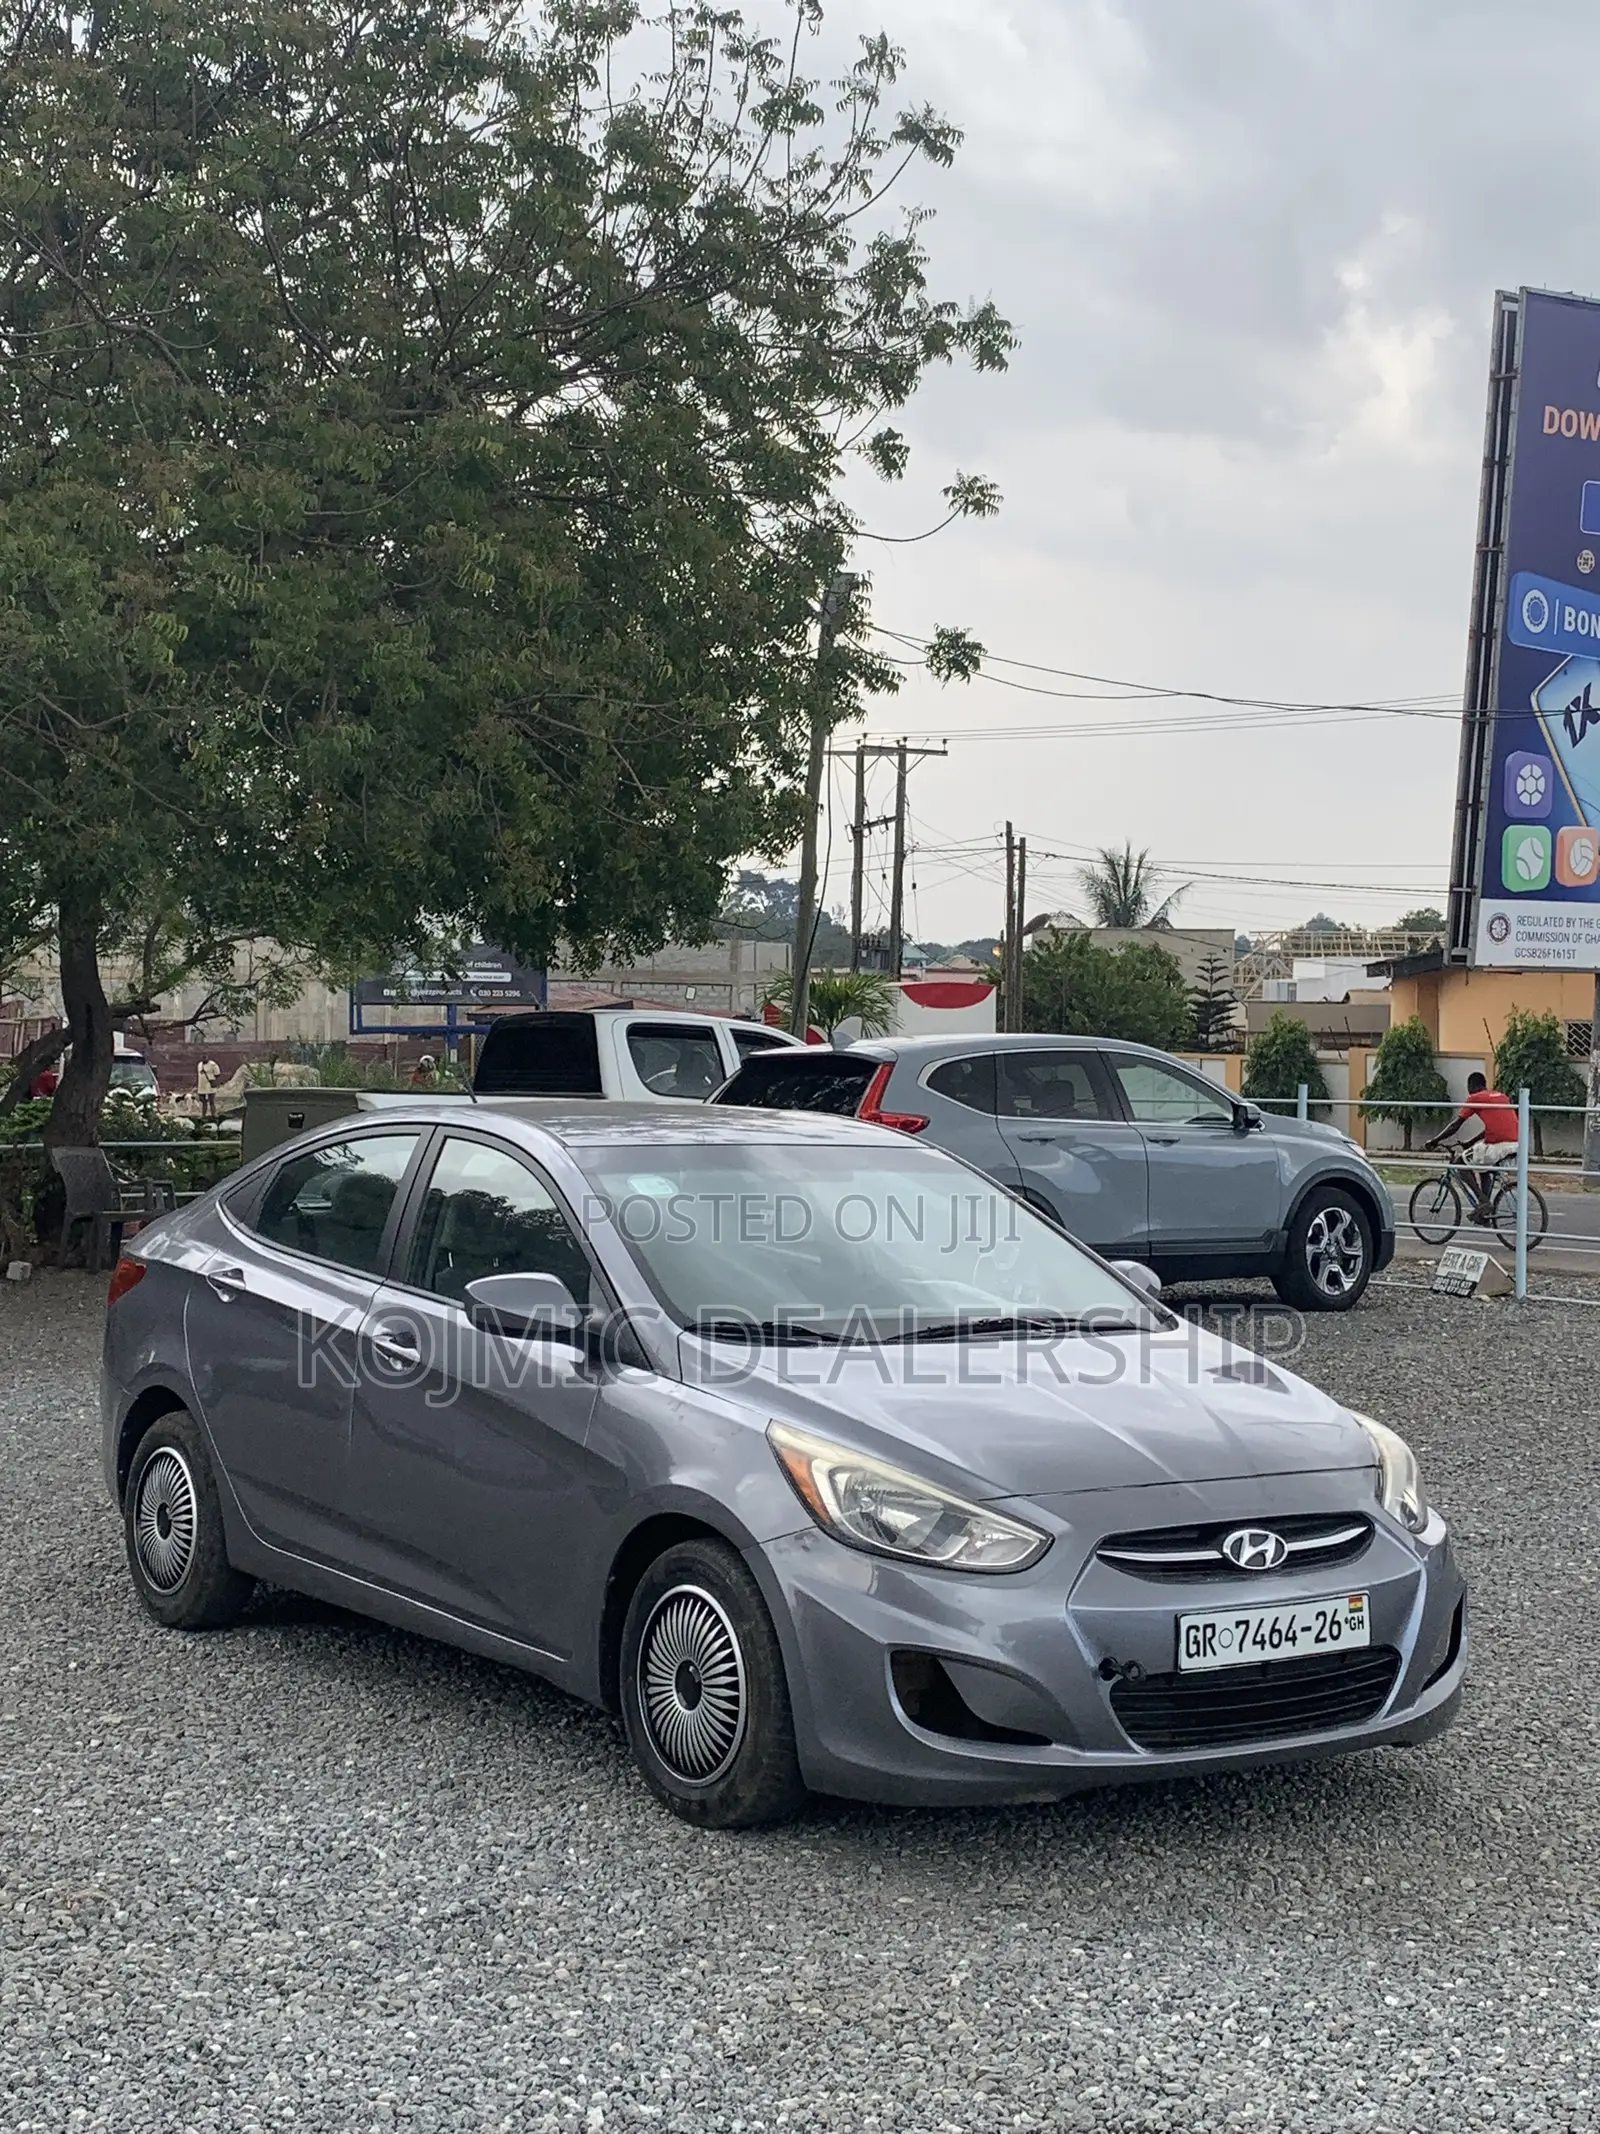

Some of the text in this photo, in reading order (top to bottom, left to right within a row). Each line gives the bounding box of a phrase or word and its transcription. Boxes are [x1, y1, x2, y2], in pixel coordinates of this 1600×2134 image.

[1543, 405, 1600, 441] DOW
[1564, 605, 1600, 639] BON
[1516, 915, 1564, 928] REGULATED
[1566, 917, 1577, 929] BY
[1579, 917, 1595, 929] THE
[1516, 931, 1570, 943] COMMISSION
[1572, 932, 1583, 944] OF
[1349, 1615, 1365, 1631] GH
